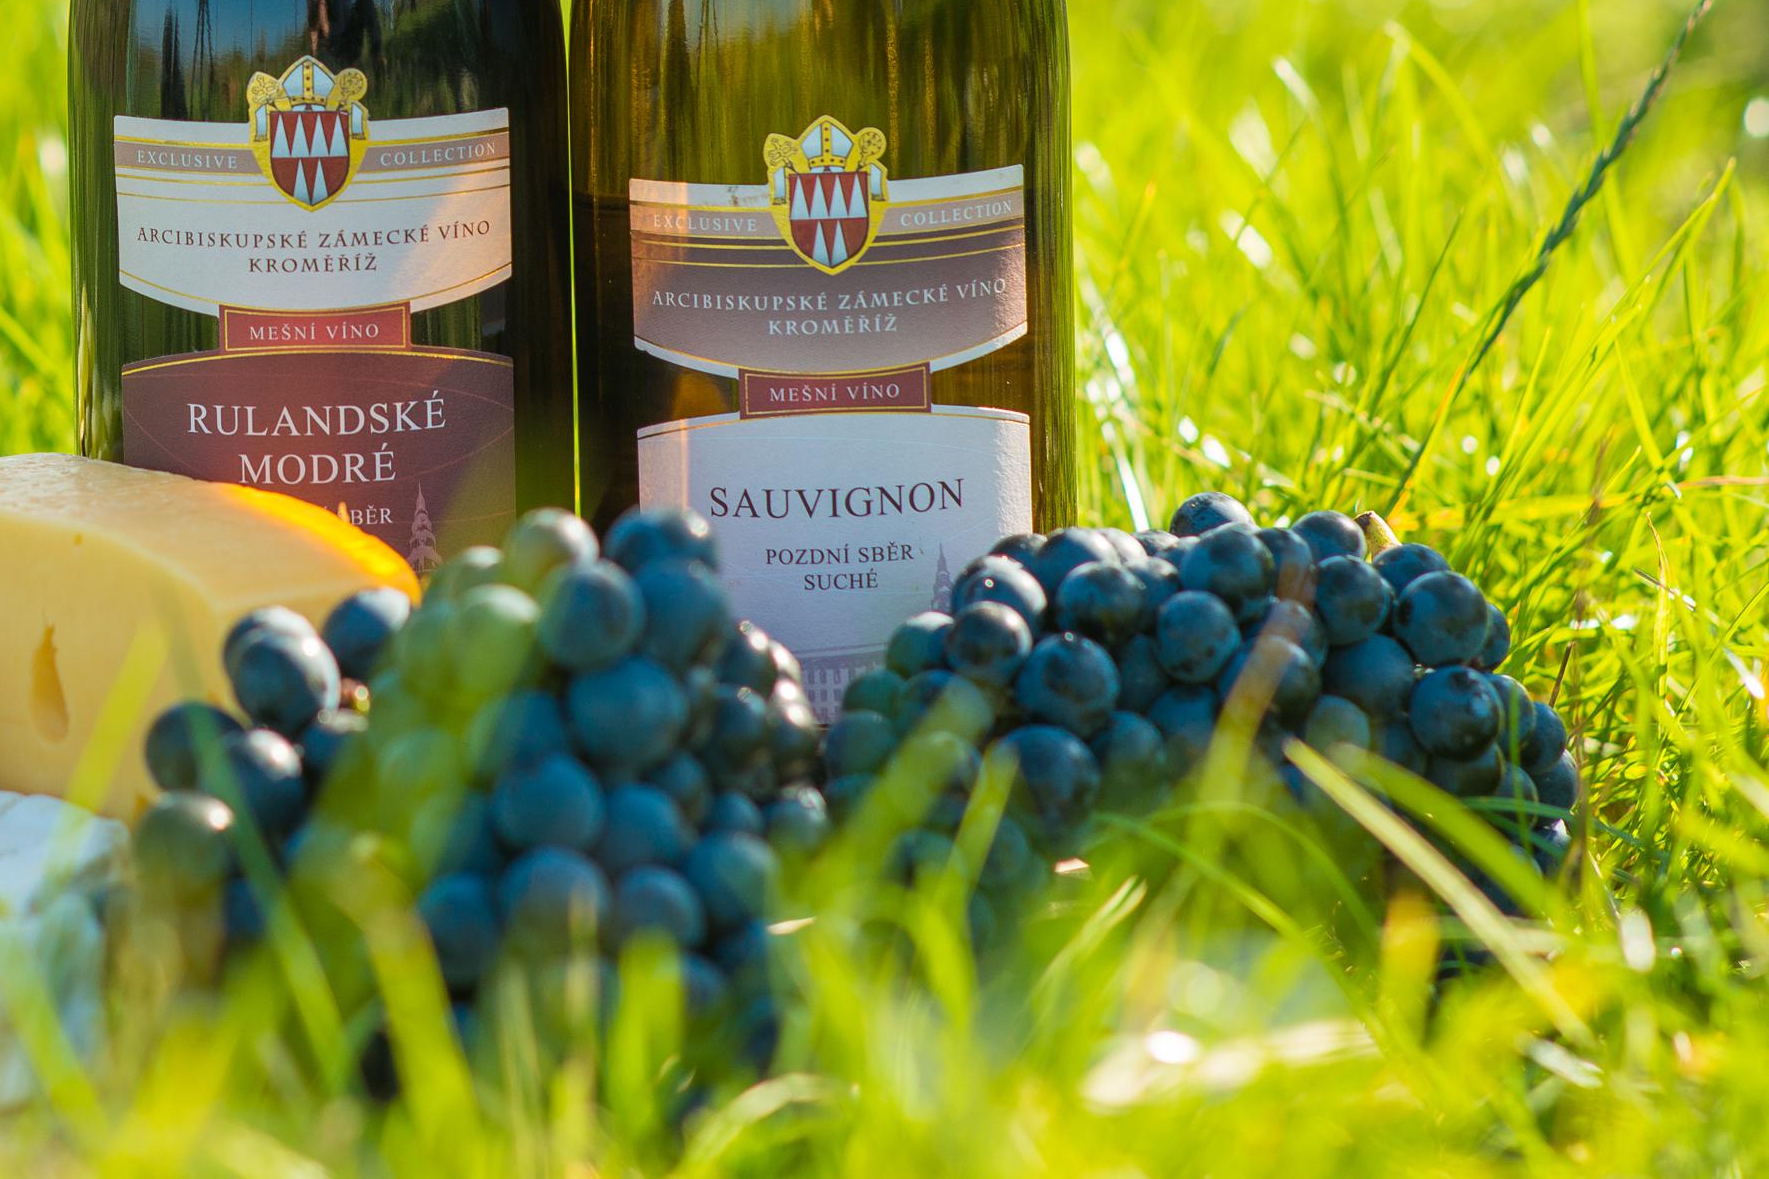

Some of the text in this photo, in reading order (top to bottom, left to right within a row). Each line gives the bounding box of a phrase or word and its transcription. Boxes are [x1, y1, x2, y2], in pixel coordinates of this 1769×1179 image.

[136, 142, 496, 170] EXCLUSIVE COLLECTION
[652, 199, 1013, 233] EXCLUSIVE COLLECTION
[136, 219, 490, 250] ARCIBISKUPSKÉ ZÁMECKÉ VÍNO
[248, 253, 379, 274] KROMĚŘÍŽ
[652, 278, 1007, 312] ARCIBISKUPSKÉ ZÁMECKÉ VÍNO
[249, 321, 379, 342] MEŠNÍ VÍNO
[768, 313, 898, 337] KROMĚŘÍŽ
[769, 383, 901, 403] MEŠNÍ VÍNO
[186, 390, 447, 437] RULANDSKÉ
[238, 443, 397, 485] MODRÉ
[709, 478, 966, 520] SAUVIGNON
[337, 503, 393, 526] BĚR
[765, 540, 915, 567] POZDNÍ SBĚR
[802, 568, 879, 592] SUCHÉ
